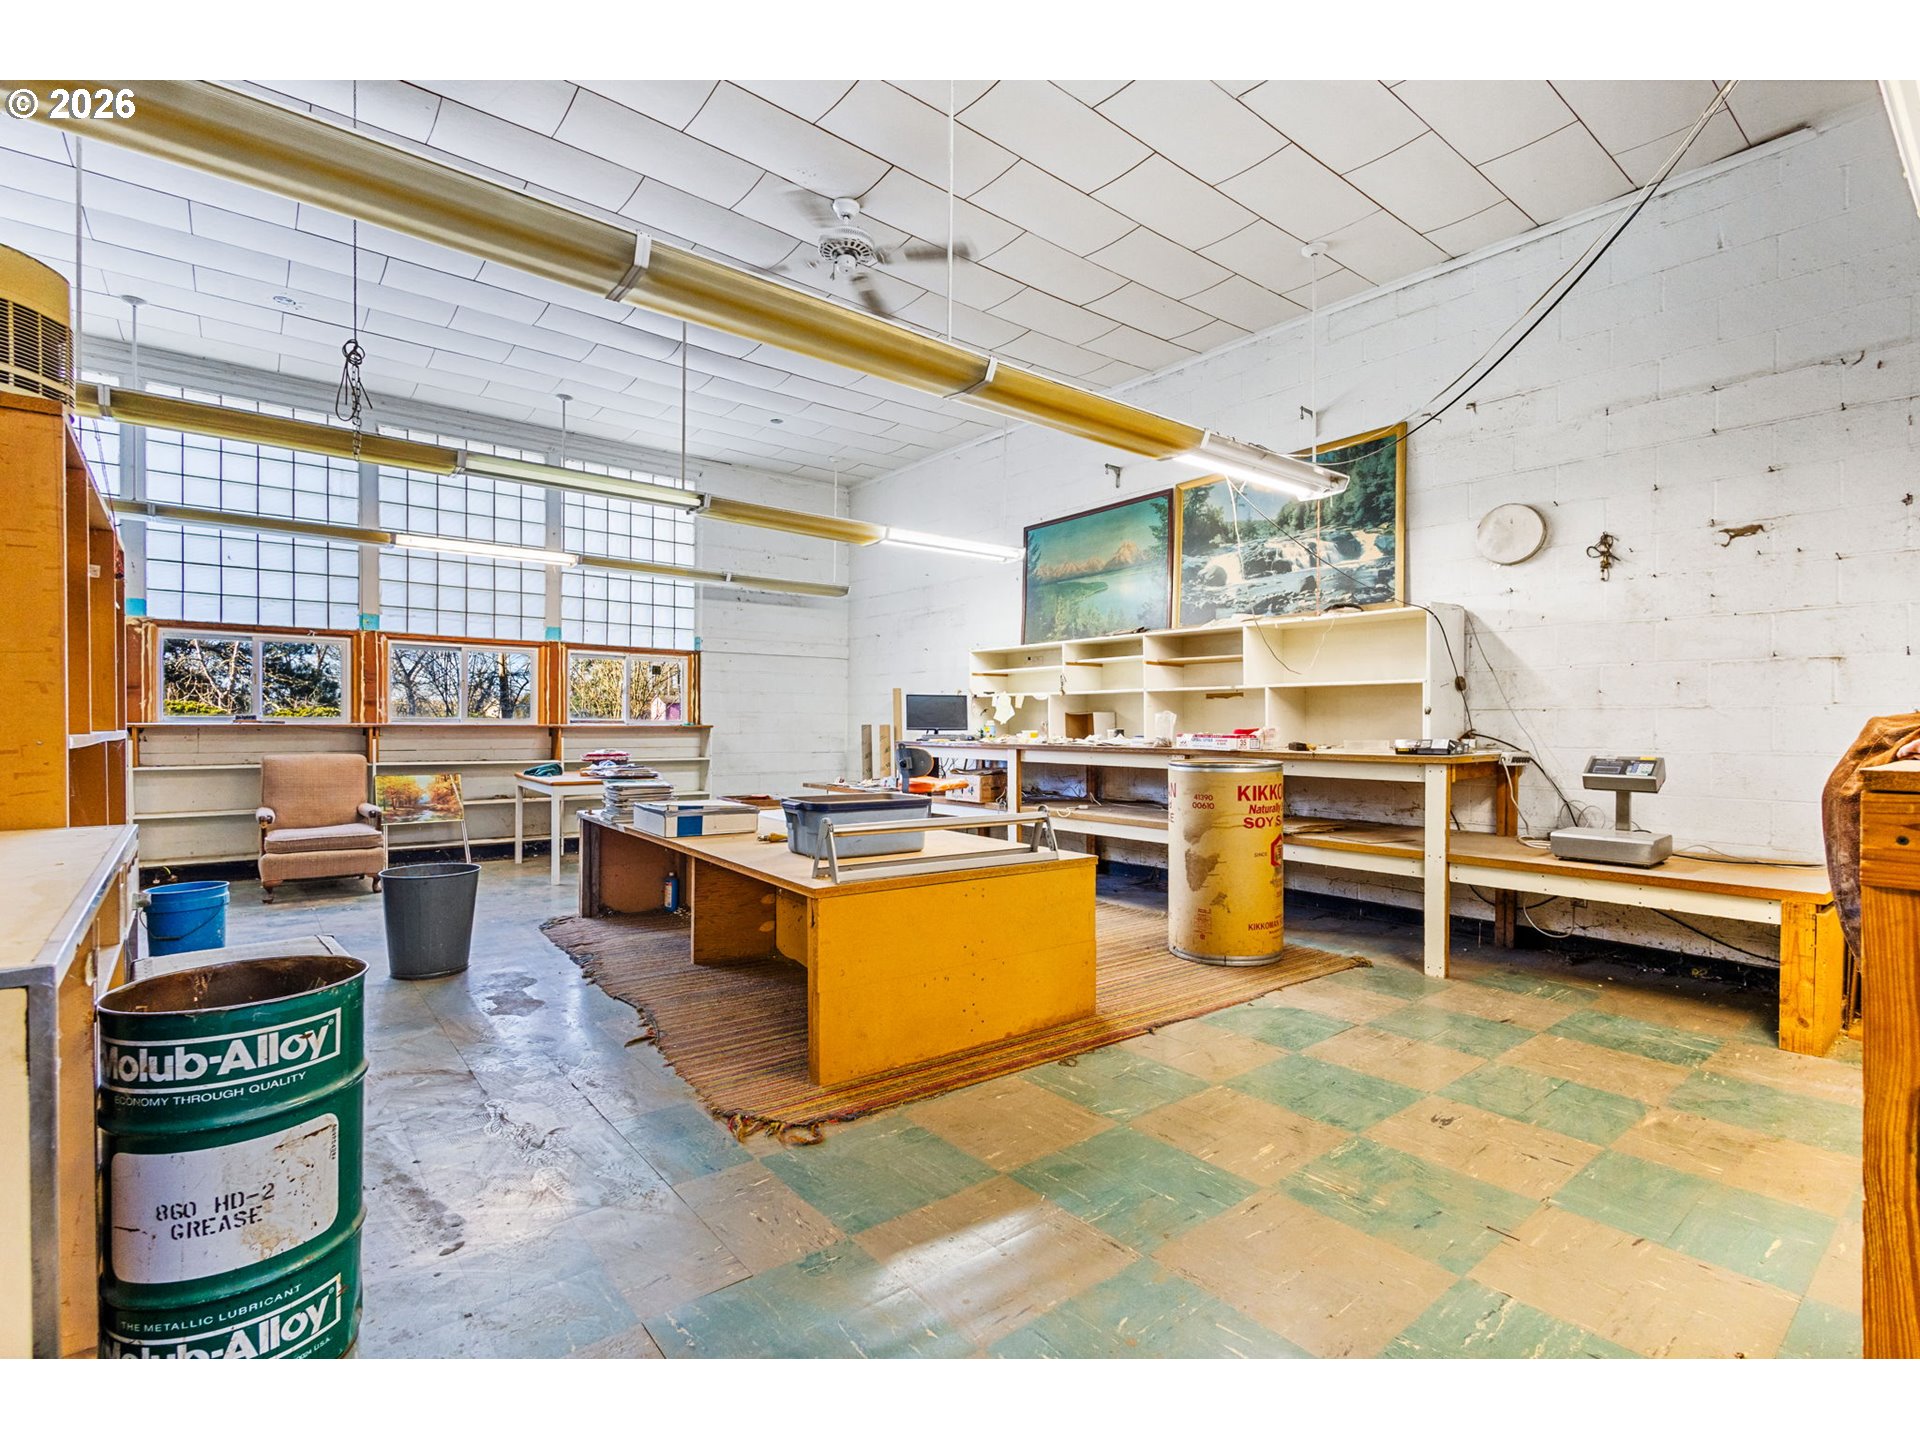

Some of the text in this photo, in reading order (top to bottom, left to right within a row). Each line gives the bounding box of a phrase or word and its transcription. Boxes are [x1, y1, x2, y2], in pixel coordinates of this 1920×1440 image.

[1243, 816, 1273, 829] SOY
[114, 1071, 306, 1107] ECONOMY THROUGH QUALITY
[214, 1182, 275, 1213] HD-2
[171, 1205, 263, 1240] GREASE
[121, 1283, 301, 1333] THE METALLIC LUBRICANT
